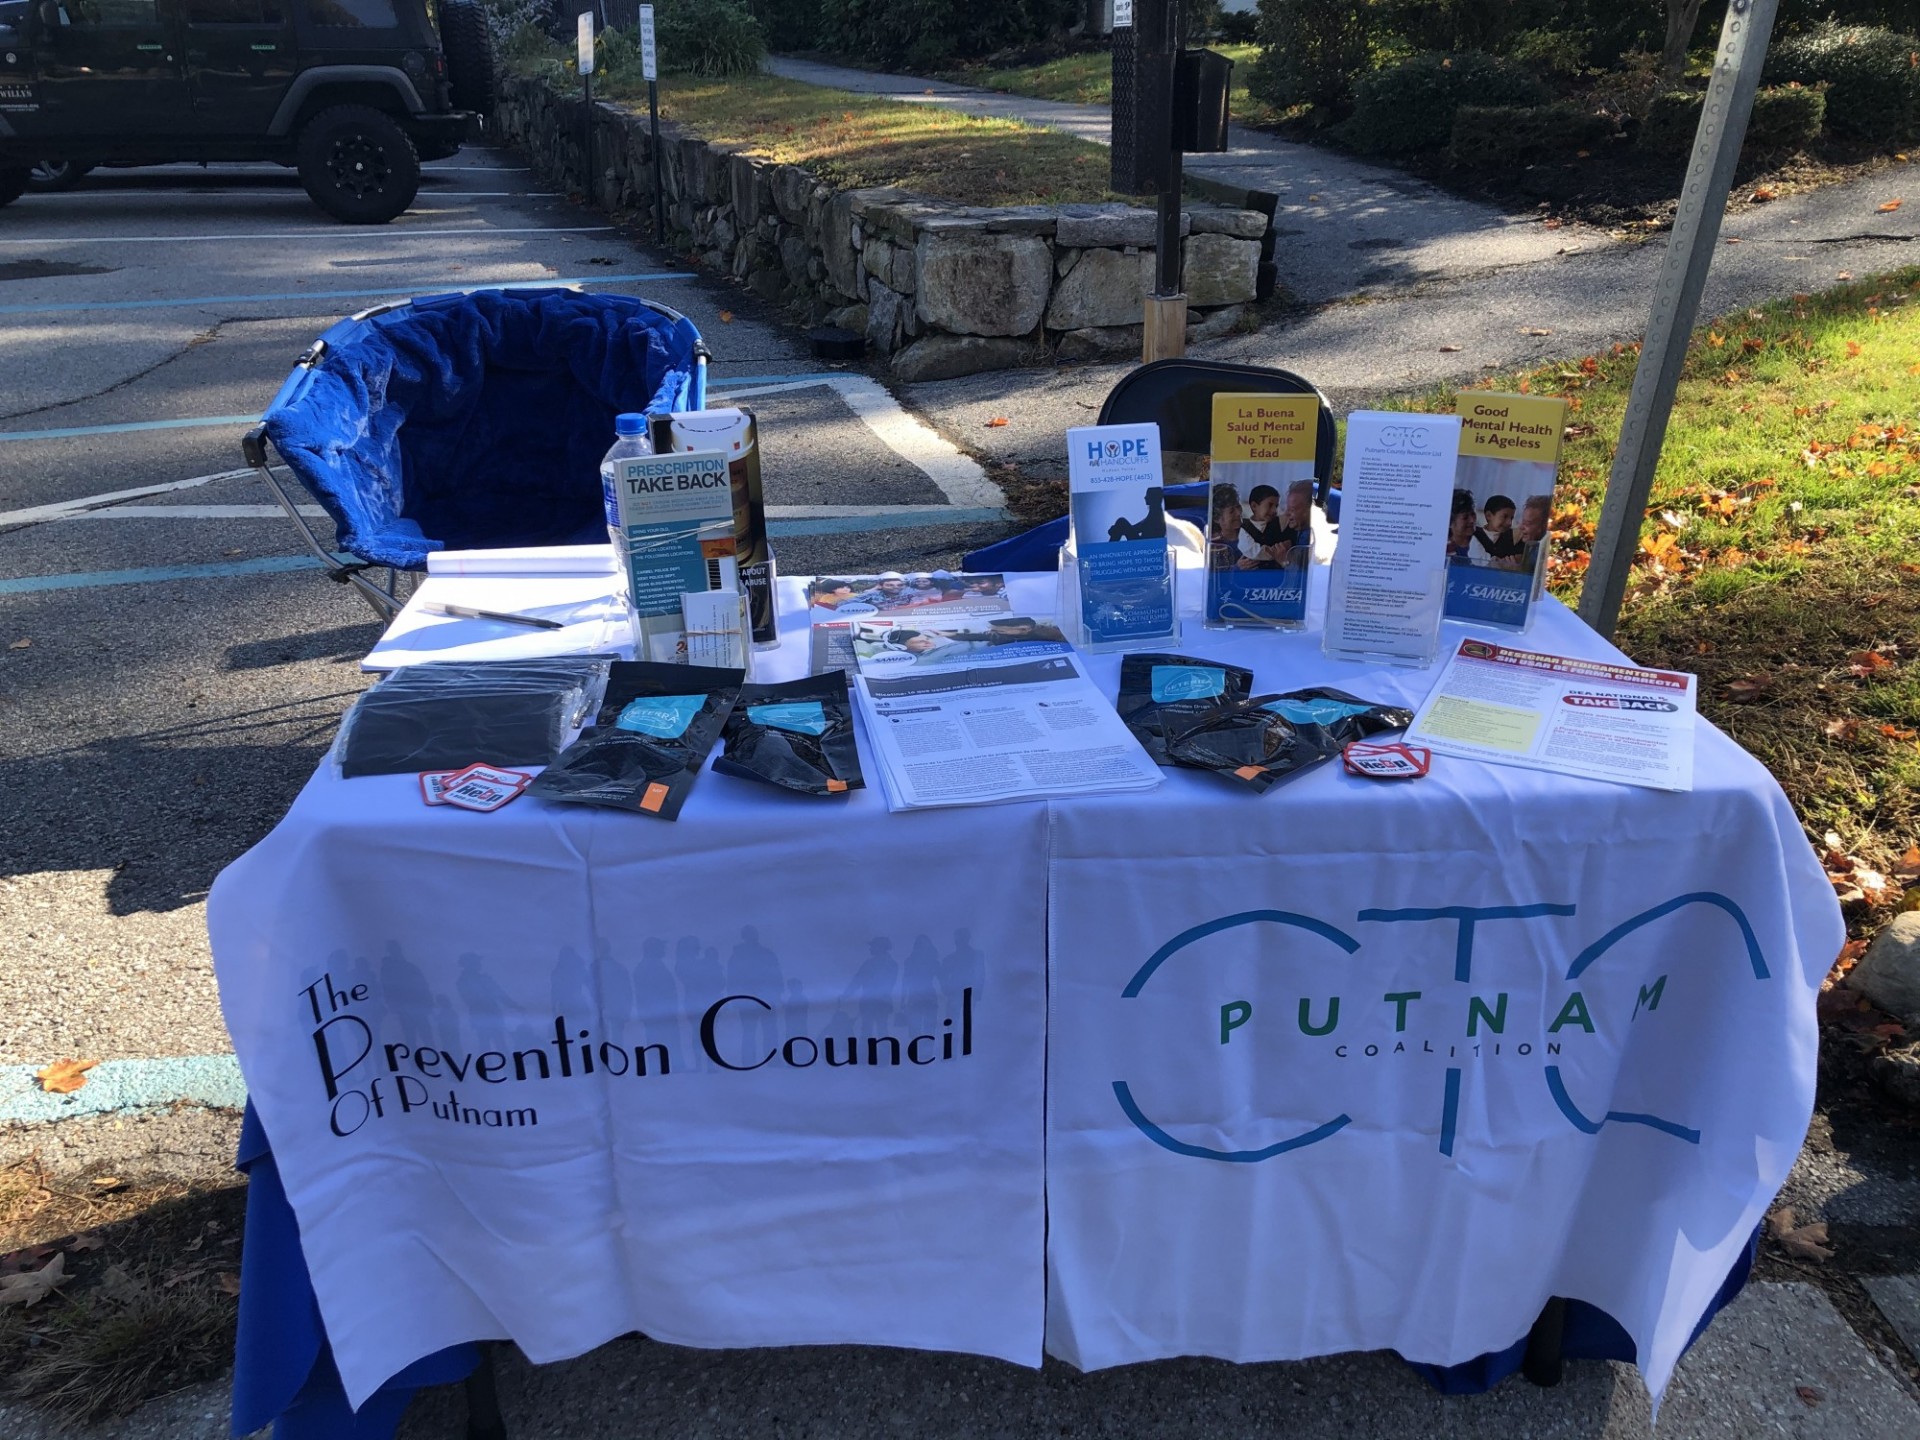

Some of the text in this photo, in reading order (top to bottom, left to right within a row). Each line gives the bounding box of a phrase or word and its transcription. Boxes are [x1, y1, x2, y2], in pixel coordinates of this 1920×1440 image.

[1238, 408, 1295, 418] La Buena
[1474, 404, 1509, 417] Good
[1227, 421, 1305, 432] Salud Mental
[1462, 417, 1553, 436] Mental Health
[1237, 434, 1294, 445] No Tiene
[1379, 425, 1430, 449] CTC
[1475, 432, 1541, 449] is Ageless
[1088, 438, 1148, 459] HOPE
[1250, 448, 1280, 458] Edad
[1386, 448, 1406, 456] County
[628, 459, 725, 478] PRESCRIPTION
[1101, 455, 1149, 466] HANDCUFFS
[627, 476, 675, 495] TAKE
[677, 472, 727, 491] BACK
[742, 567, 766, 576] ABOUT
[744, 578, 767, 587] ABUSE
[1249, 588, 1303, 601] SAMHSA
[1469, 586, 1527, 604] SAMHSA
[1496, 655, 1681, 688] SIN USAR DE FORMA CORRECTA
[1499, 649, 1658, 679] DESECHAR MEDICAMENTOS
[1569, 697, 1672, 711] TAKE BACK
[1594, 691, 1654, 700] NATIONAL
[298, 973, 369, 1025] The
[1219, 974, 1668, 1045] PUTNAM
[312, 986, 972, 1101] Prevention Council
[1334, 1039, 1563, 1059] COALITION
[330, 1074, 538, 1138] Of Putnam
